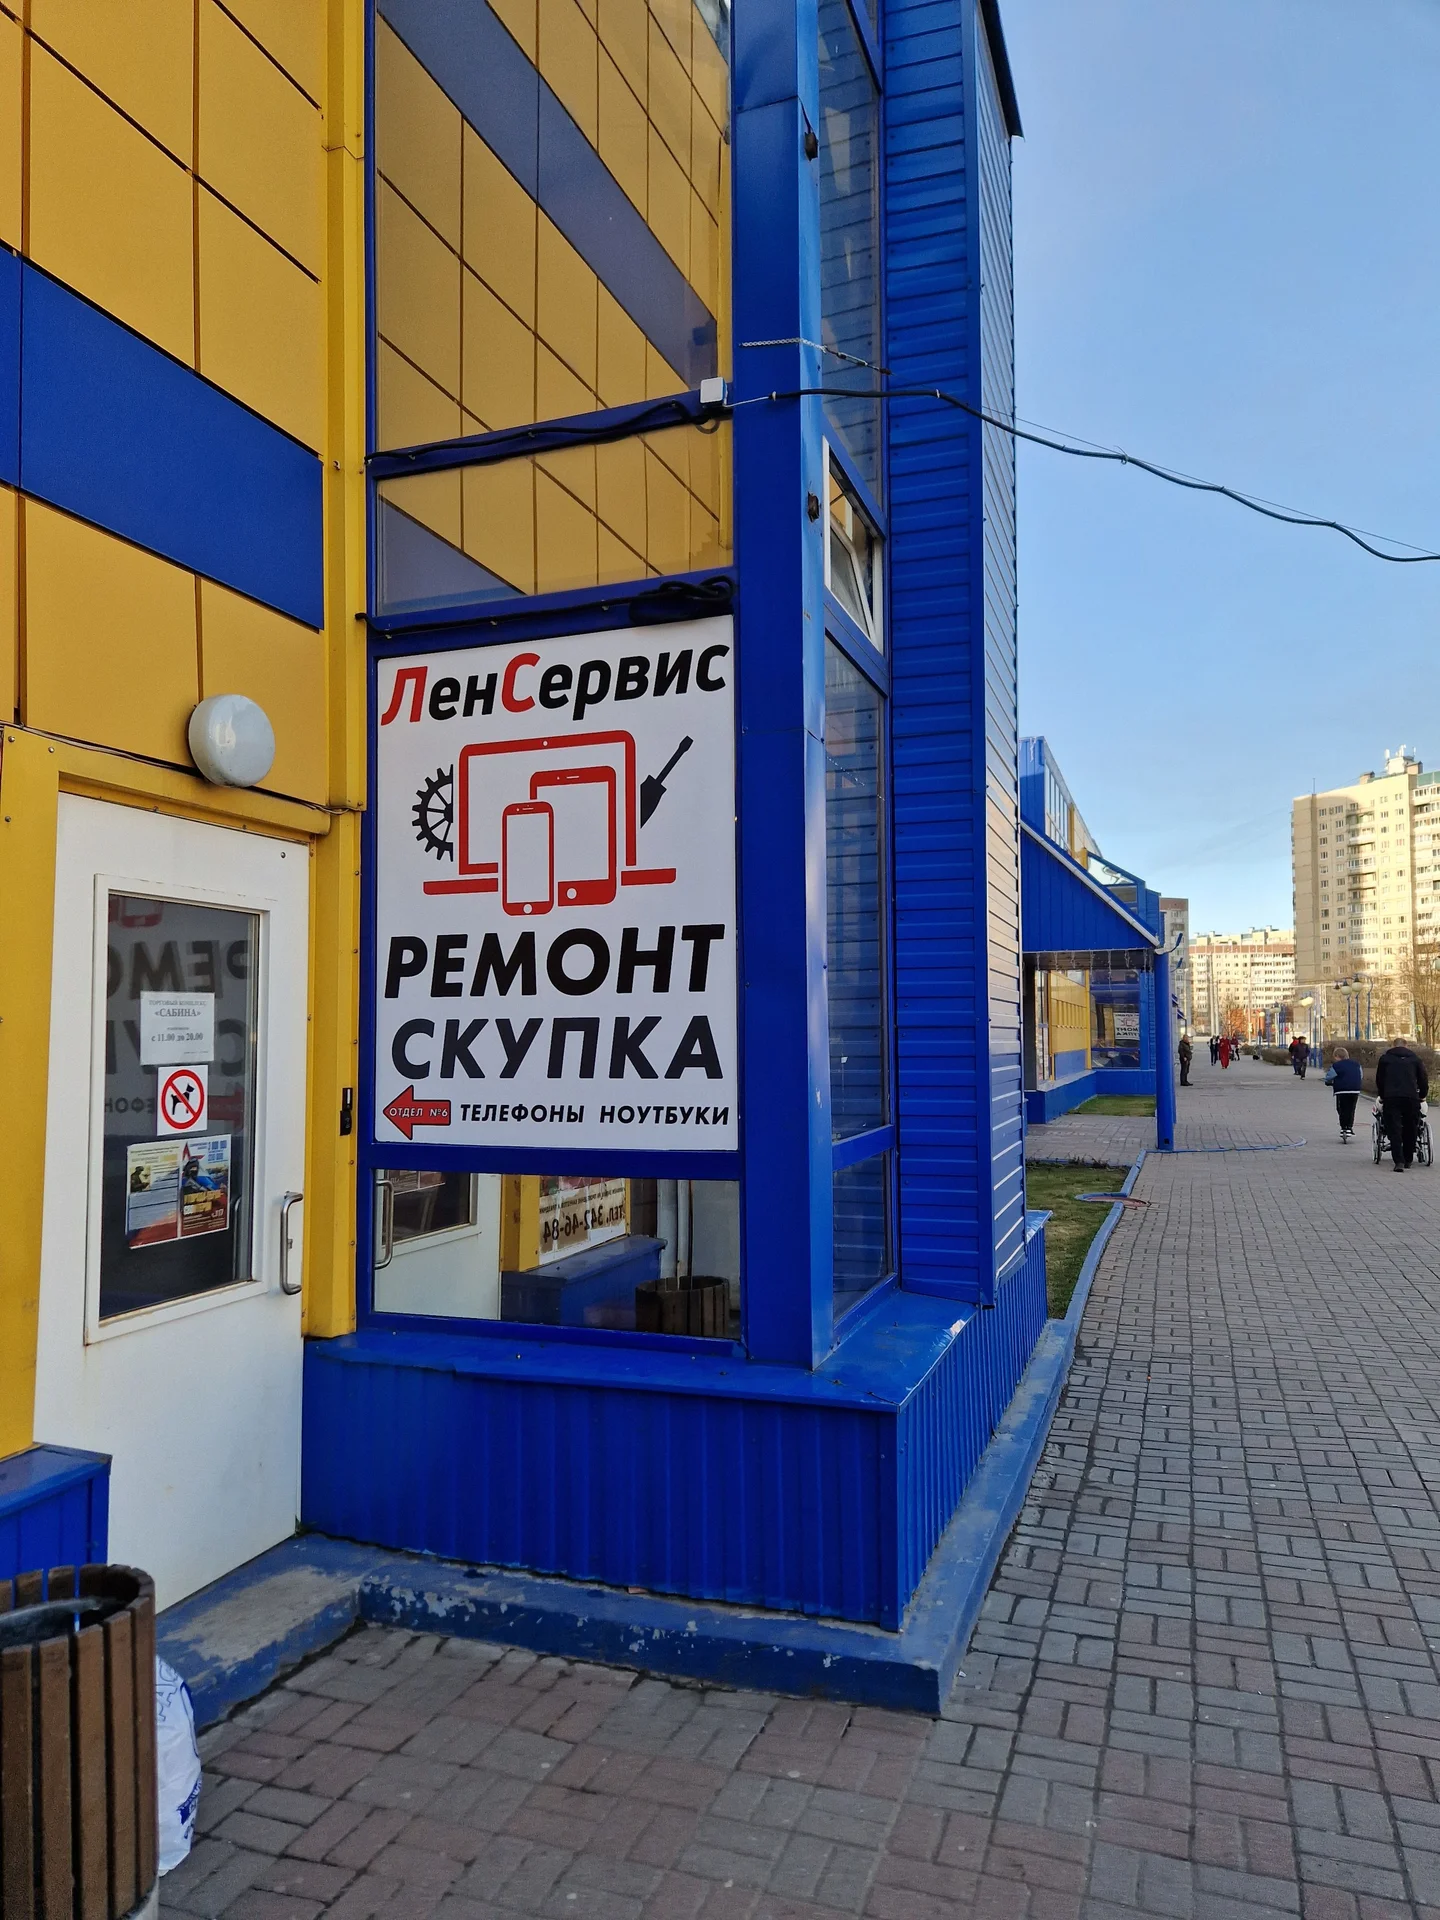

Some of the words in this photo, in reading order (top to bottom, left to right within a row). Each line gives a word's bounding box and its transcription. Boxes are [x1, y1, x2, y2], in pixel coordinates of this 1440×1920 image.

[380, 644, 730, 726] ЛенСервис
[384, 924, 725, 998] РЕМОНТ
[154, 1008, 201, 1017] «САБИНА»
[157, 1034, 175, 1042] 11.00
[186, 1033, 204, 1041] 20.00
[391, 1015, 723, 1079] СКУПКА
[389, 1107, 423, 1118] ОТДЕЛ
[430, 1108, 448, 1117] №6
[460, 1103, 585, 1123] ТЕЛЕФОНЫ
[599, 1105, 730, 1125] НОУТБУКИ
